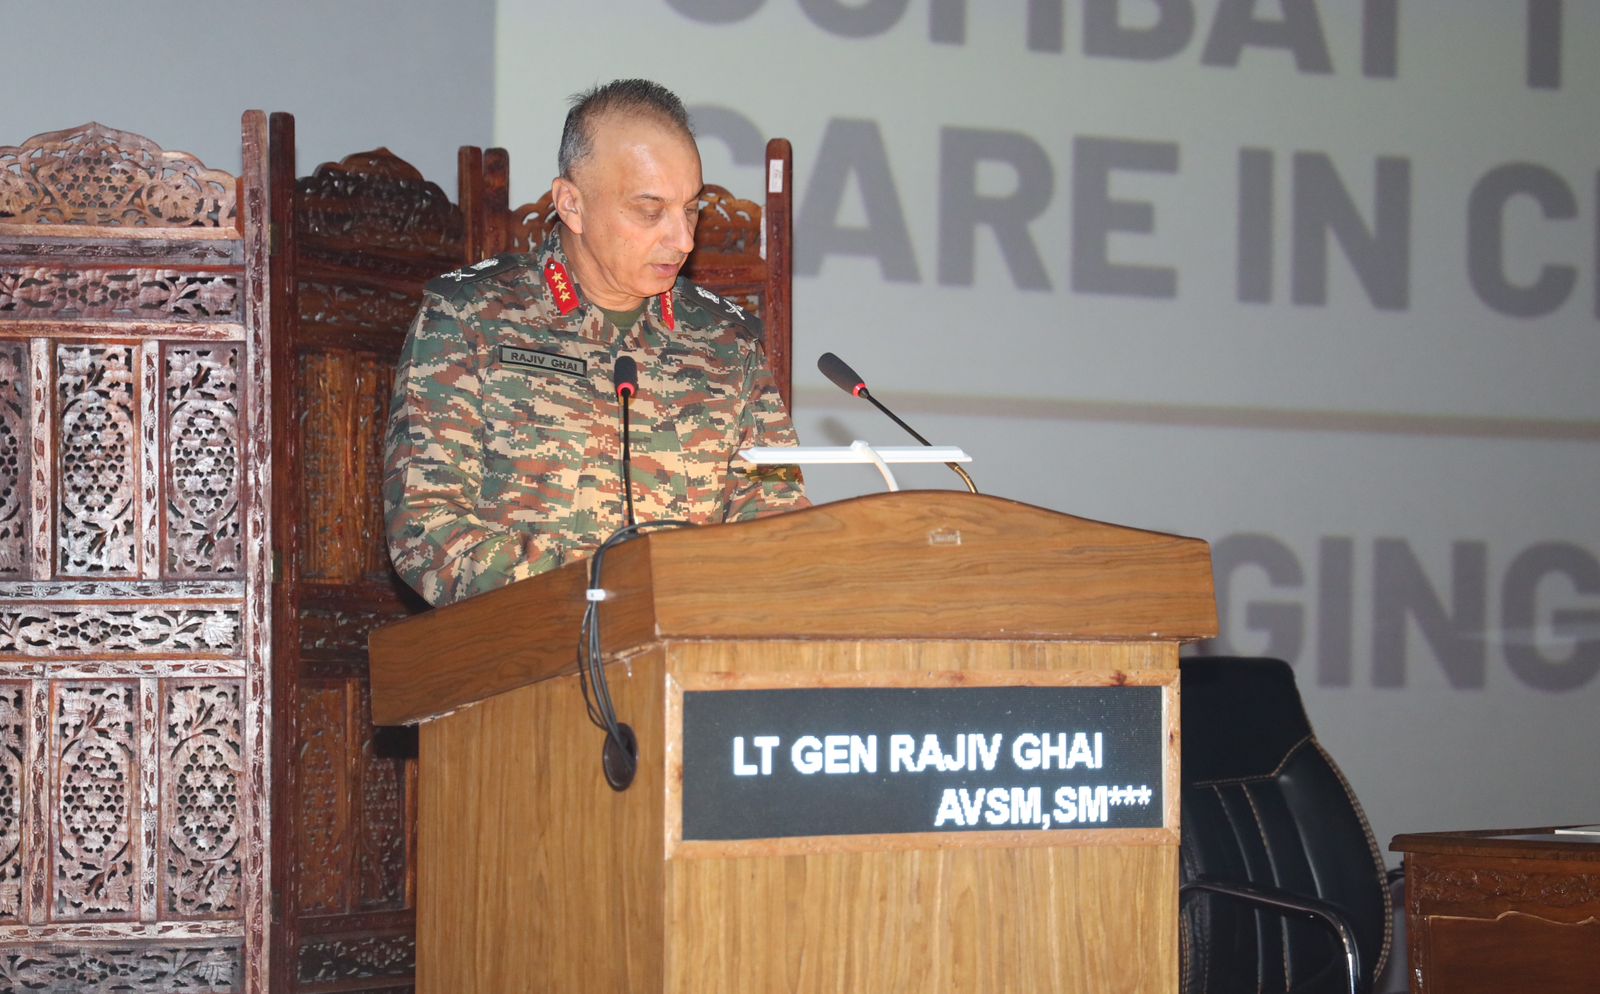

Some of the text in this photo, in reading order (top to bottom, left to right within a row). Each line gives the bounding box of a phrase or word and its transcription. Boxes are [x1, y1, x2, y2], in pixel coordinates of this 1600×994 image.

[690, 104, 1600, 321] ARE IN C
[511, 352, 578, 372] RAJIV GHAI
[733, 732, 1103, 775] LT GEN RAJIV GHAI
